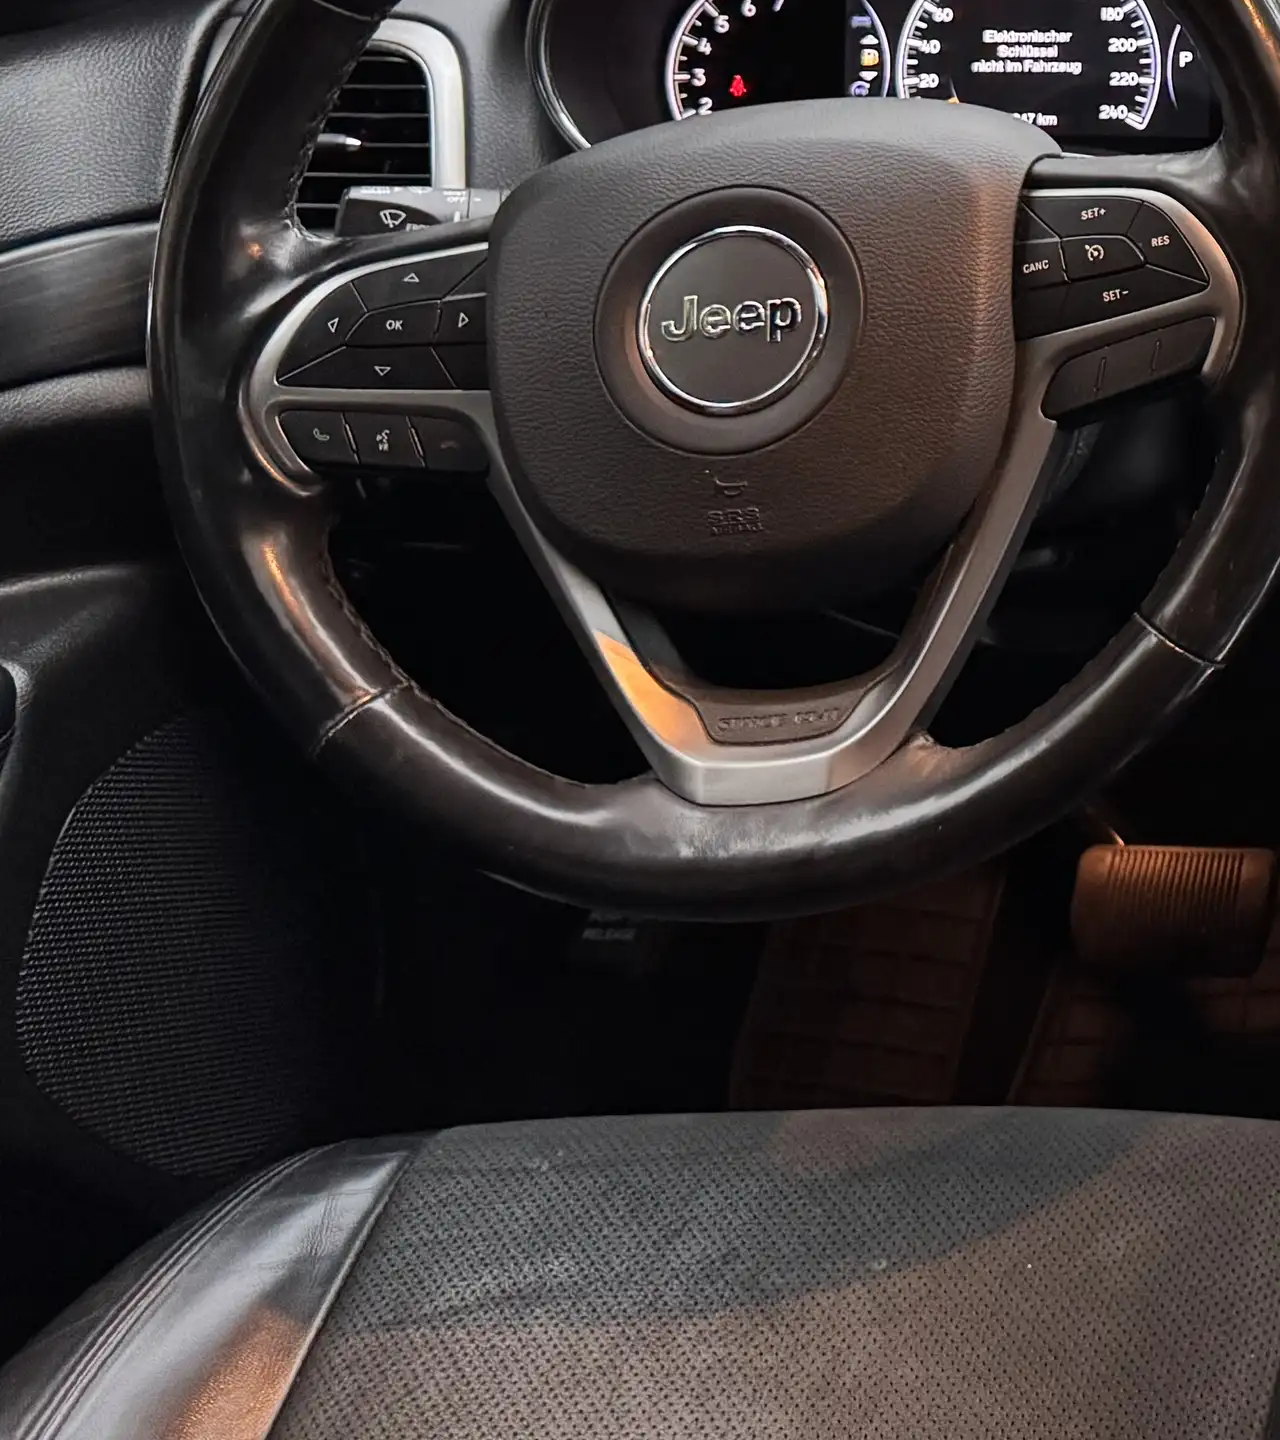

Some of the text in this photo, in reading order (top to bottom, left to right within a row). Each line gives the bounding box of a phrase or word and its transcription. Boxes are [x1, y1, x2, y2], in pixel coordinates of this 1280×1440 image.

[931, 7, 954, 22] 60
[713, 14, 731, 34] 5
[982, 29, 1073, 44] Elektronischer
[1108, 37, 1138, 52] 200
[696, 36, 713, 56] 4
[920, 38, 941, 55] 40
[996, 44, 1059, 59] Schlüssel
[970, 59, 1082, 75] nicht im Fahrzeug
[1178, 50, 1193, 68] P
[690, 67, 707, 87] 3
[918, 72, 940, 89] 20
[1109, 71, 1140, 87] 220
[697, 96, 713, 116] 2
[1098, 104, 1128, 120] 240
[1036, 111, 1058, 126] km
[1150, 234, 1171, 248] RES
[1022, 259, 1050, 274] CANC
[386, 319, 404, 331] OK
[661, 295, 802, 344] Jeep
